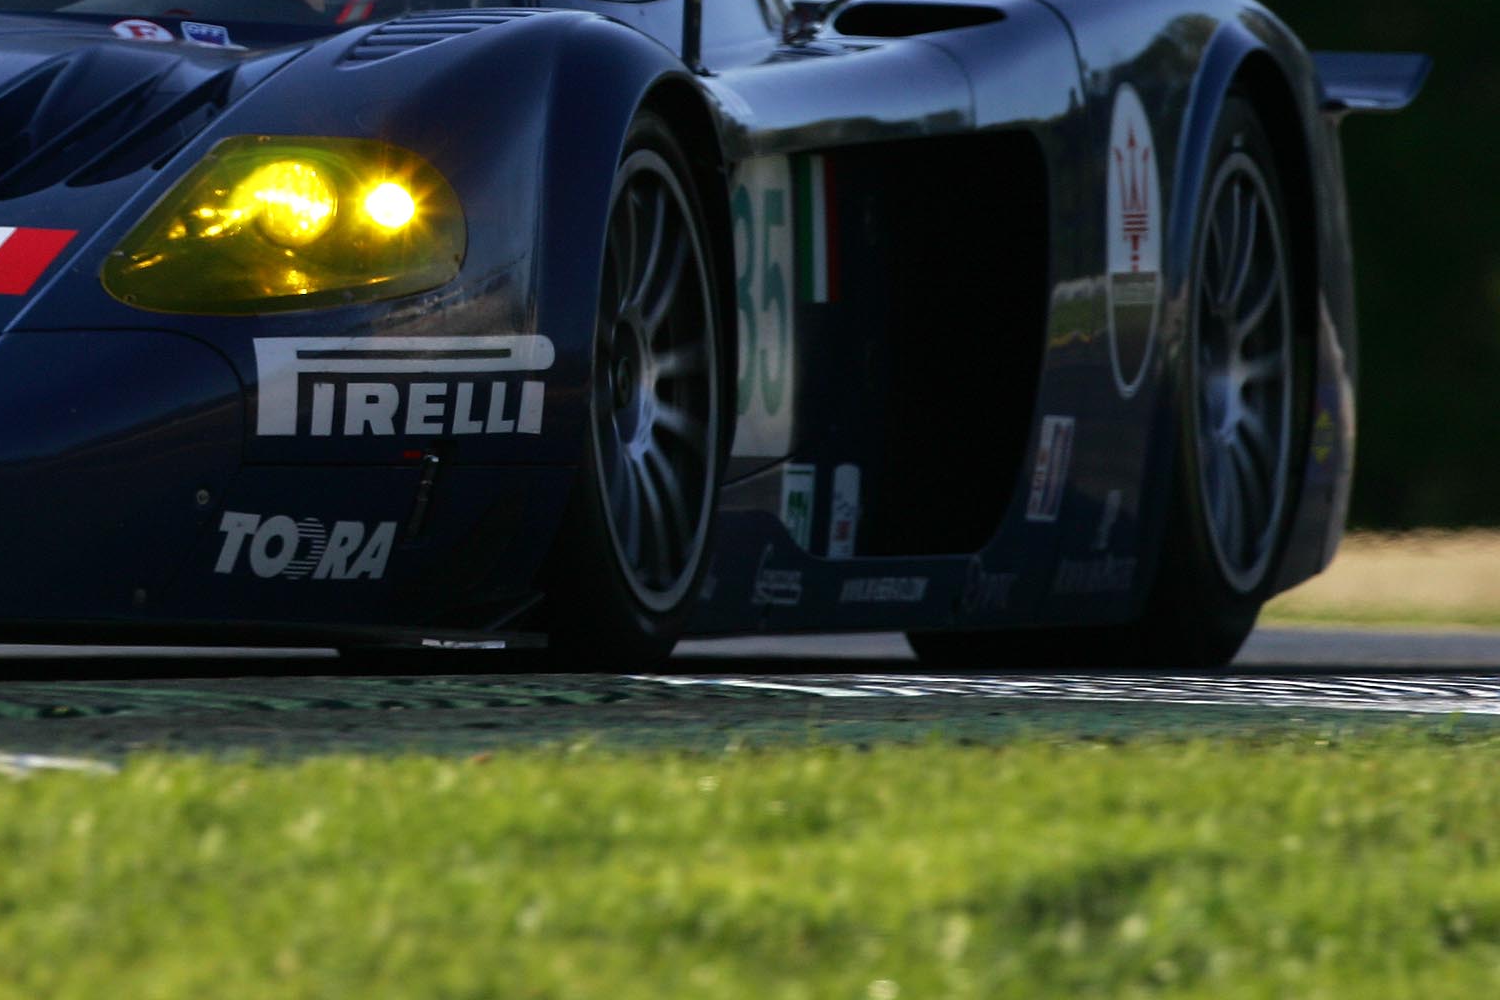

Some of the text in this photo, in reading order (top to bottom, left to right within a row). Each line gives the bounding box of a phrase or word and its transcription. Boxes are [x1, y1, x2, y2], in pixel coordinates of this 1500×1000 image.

[732, 184, 788, 416] 35
[253, 334, 556, 437] PIRELLI
[214, 511, 398, 581] TOORA
